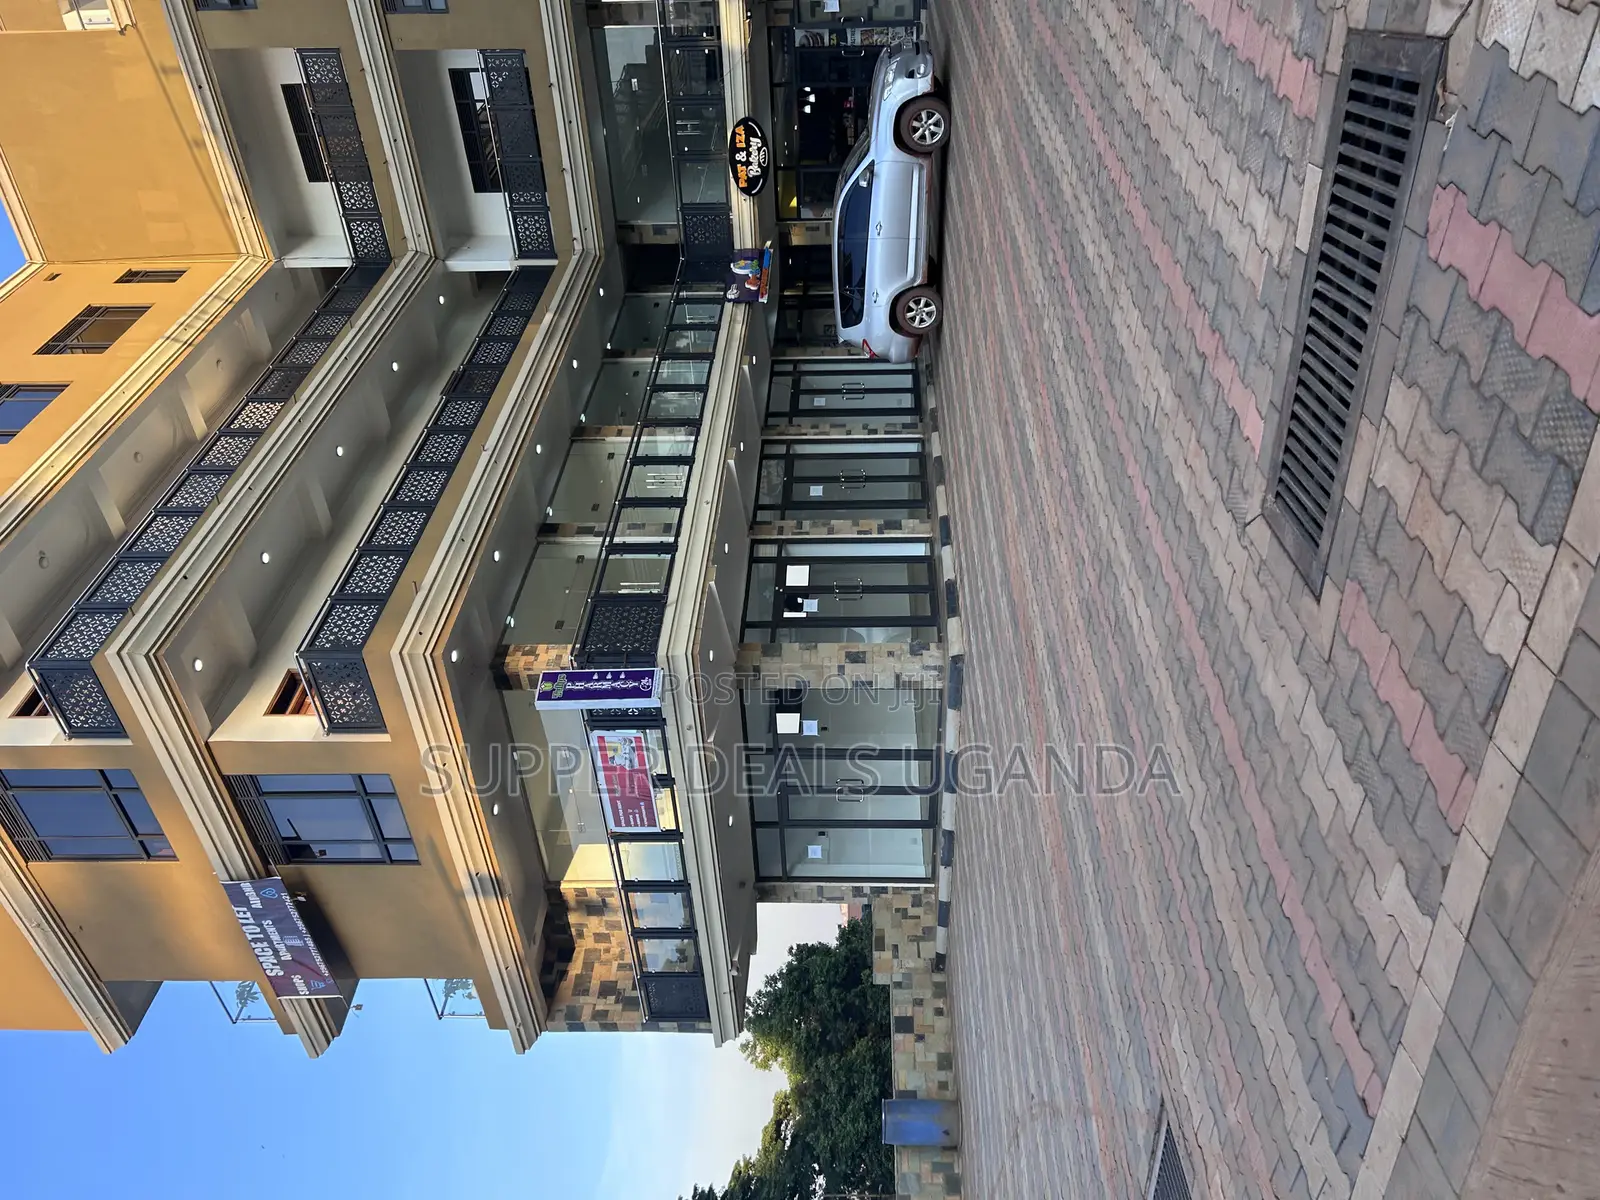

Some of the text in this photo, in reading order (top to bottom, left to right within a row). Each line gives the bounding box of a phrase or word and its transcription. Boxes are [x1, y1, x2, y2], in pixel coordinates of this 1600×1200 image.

[735, 125, 747, 187] PAT & IZA
[747, 137, 761, 177] Bakery
[566, 680, 639, 689] PHARMACY
[232, 905, 284, 976] SPACE TO LET
[262, 920, 292, 960] APARTMENTS
[291, 975, 309, 995] SHOPS
